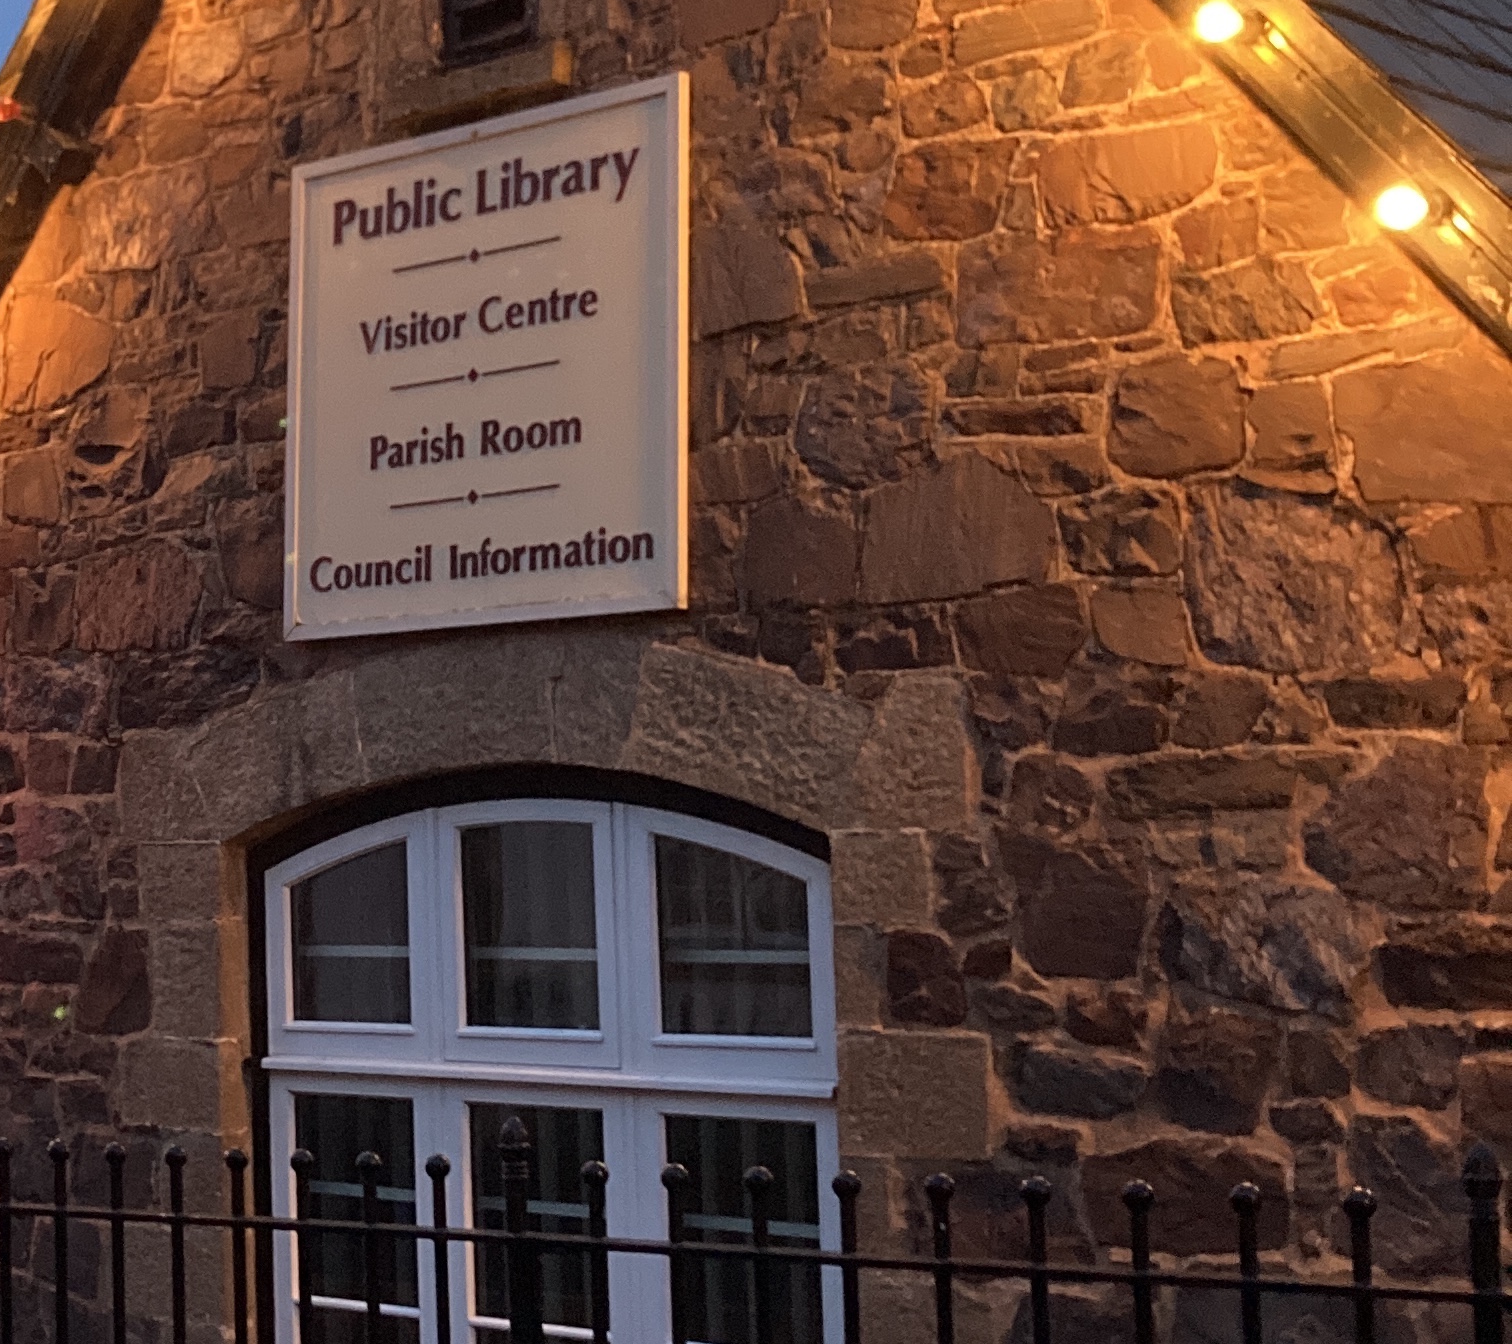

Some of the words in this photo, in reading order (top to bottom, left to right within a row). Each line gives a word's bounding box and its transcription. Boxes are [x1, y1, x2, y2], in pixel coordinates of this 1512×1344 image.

[333, 178, 462, 245] Public
[475, 148, 640, 216] Library
[360, 310, 467, 355] Visitor
[478, 285, 599, 334] Centre
[369, 423, 465, 470] Parish
[479, 416, 582, 457] Room
[309, 545, 432, 593] Council
[448, 528, 655, 581] Information
